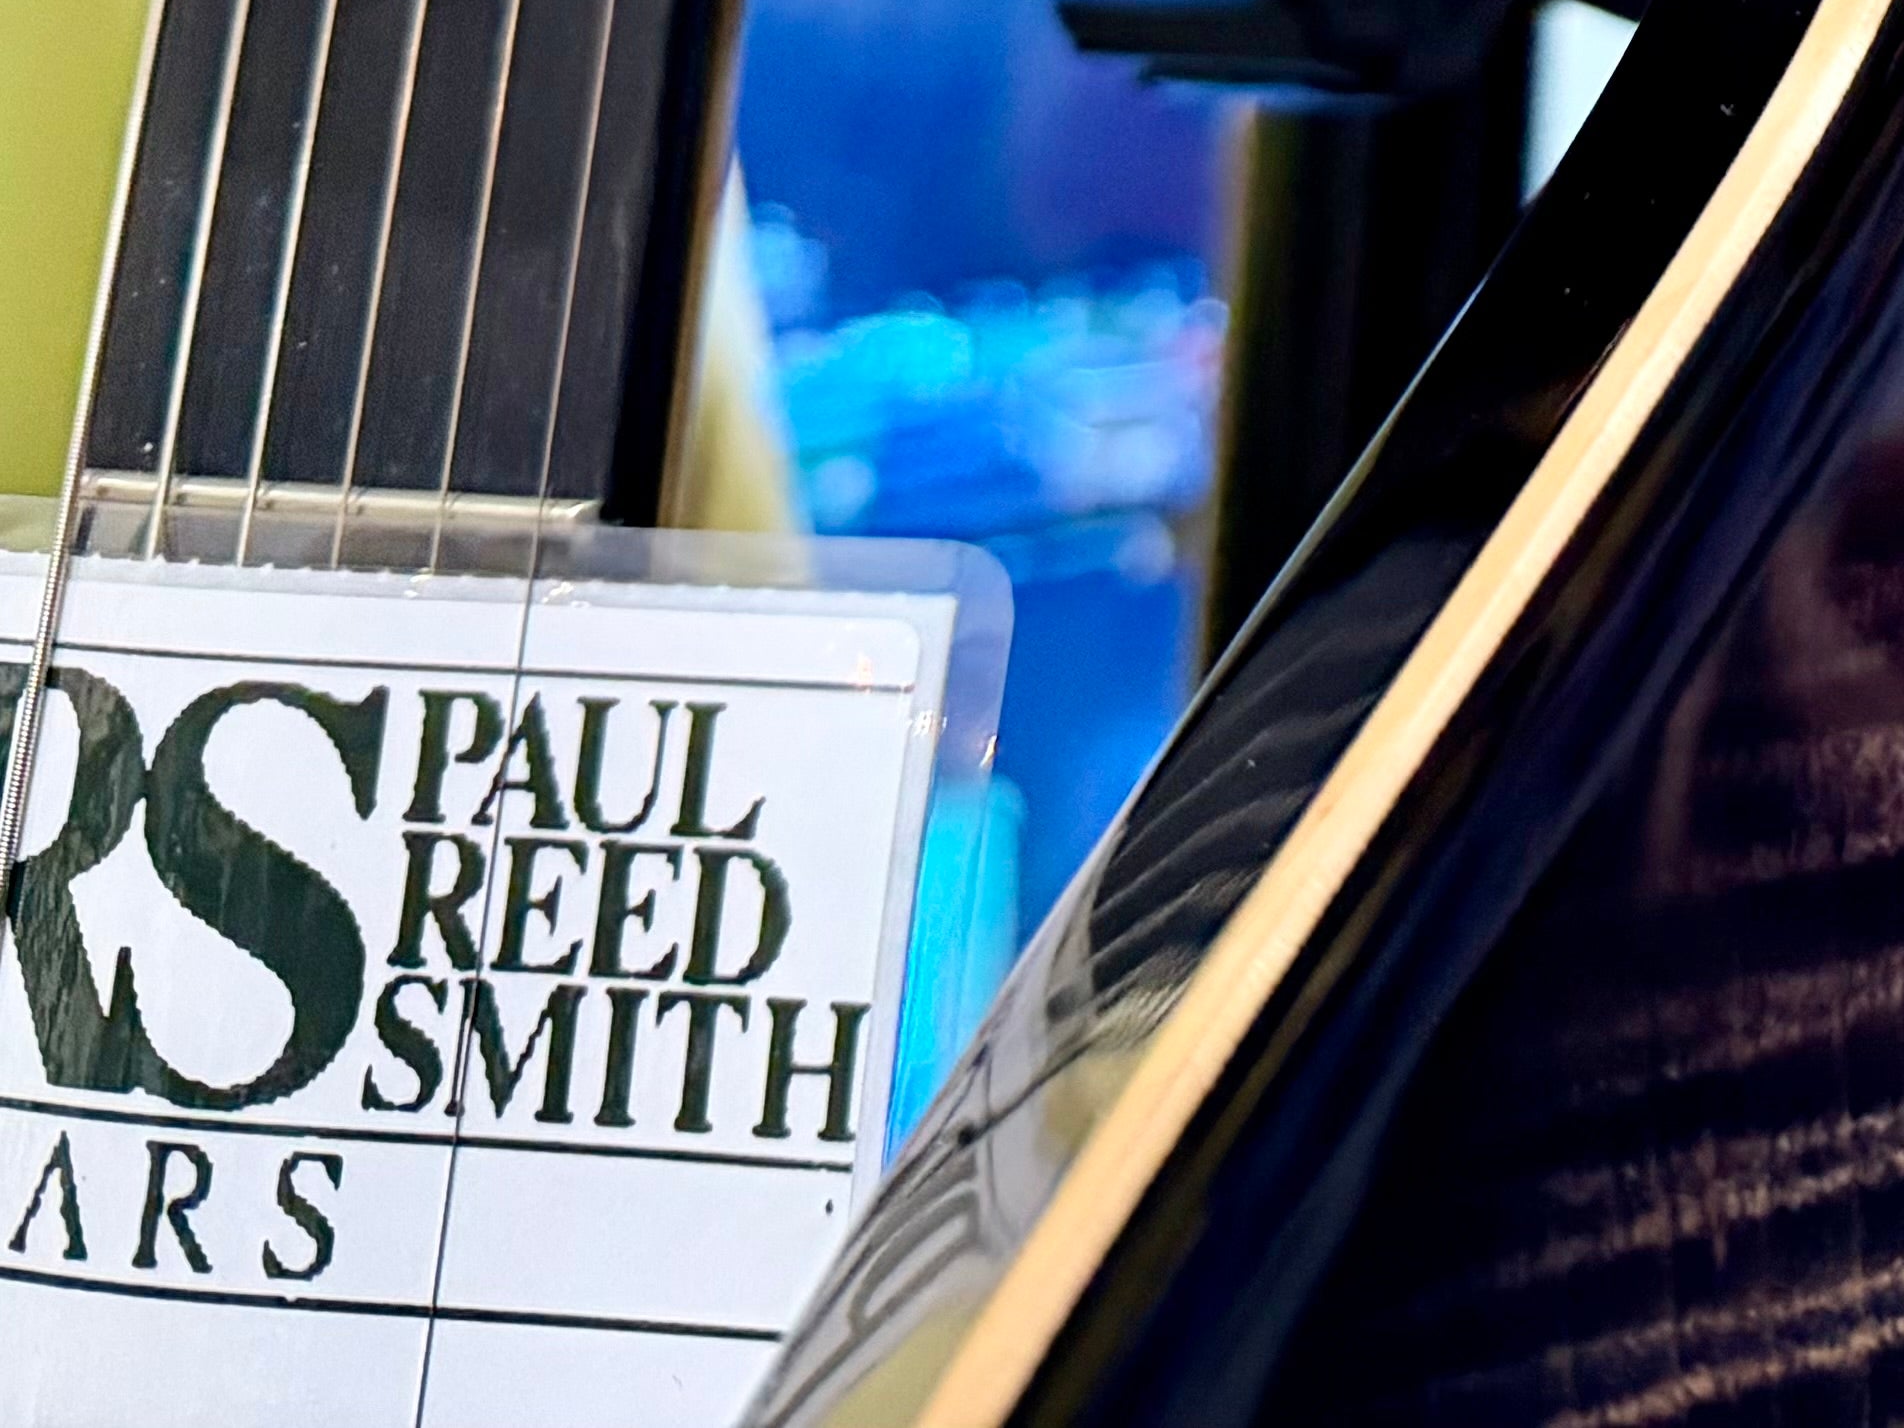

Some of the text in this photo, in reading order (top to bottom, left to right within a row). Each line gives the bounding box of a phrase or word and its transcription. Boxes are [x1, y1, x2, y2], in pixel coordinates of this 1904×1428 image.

[402, 688, 766, 840] PAUL
[386, 831, 794, 986] REED
[361, 973, 871, 1142] SMITH
[8, 1131, 345, 1281] ARS
